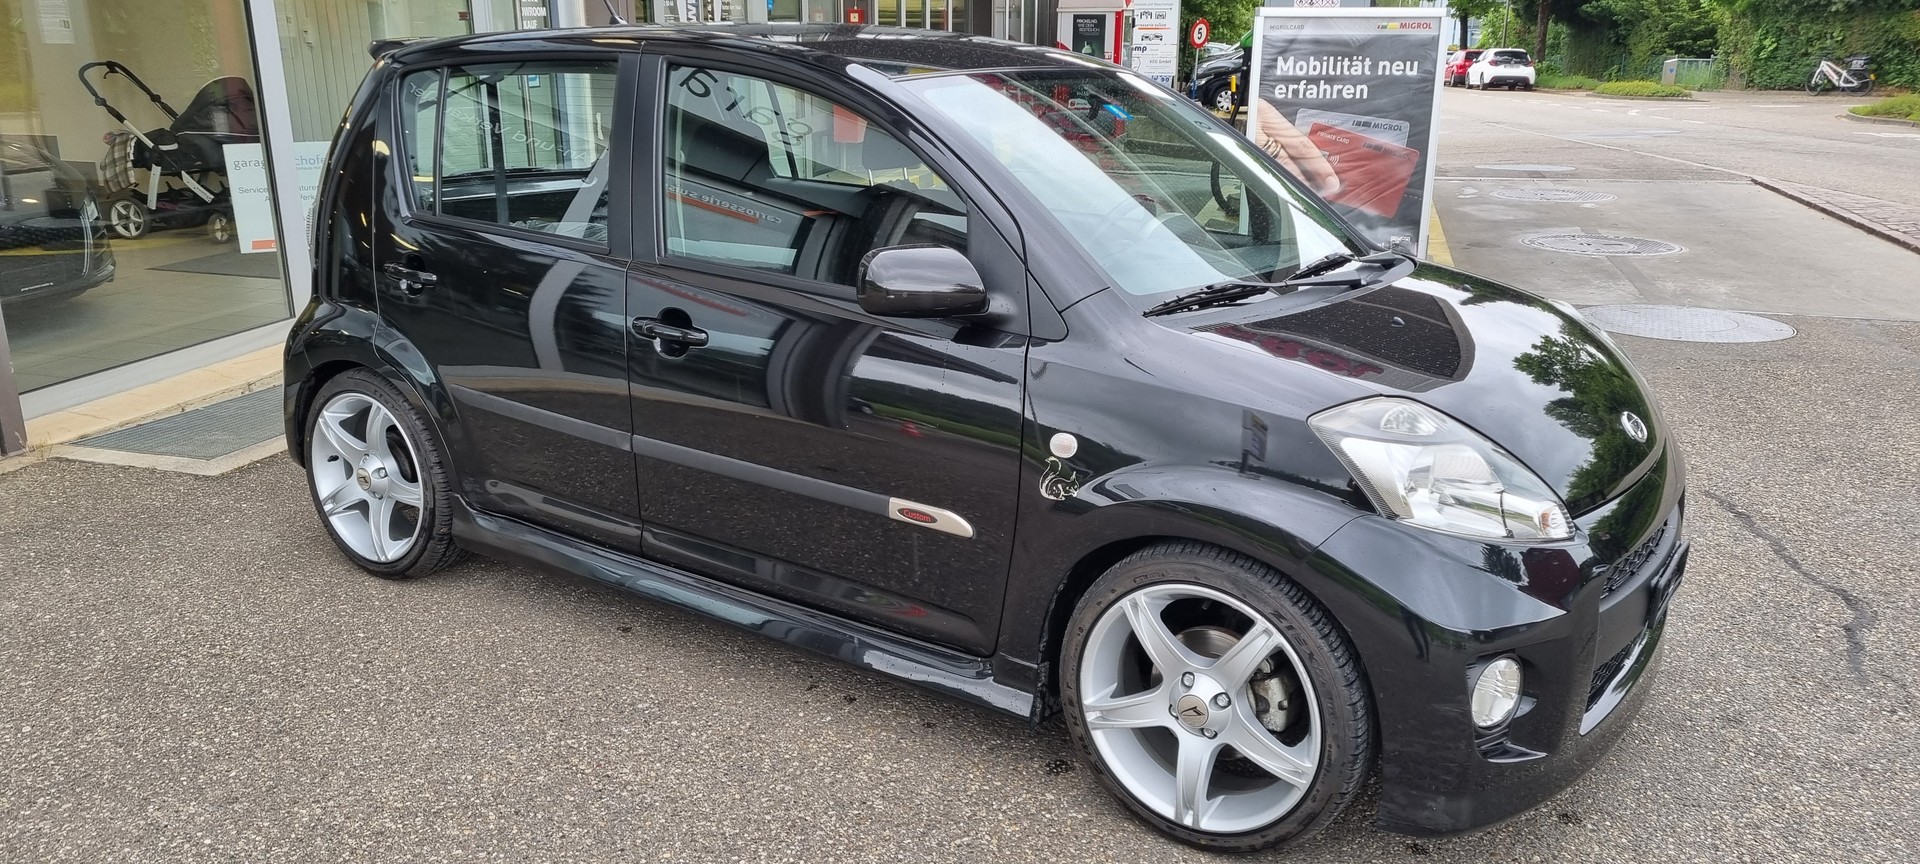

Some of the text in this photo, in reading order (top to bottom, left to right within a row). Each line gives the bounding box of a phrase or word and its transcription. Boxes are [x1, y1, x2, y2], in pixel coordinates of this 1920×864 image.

[521, 7, 547, 16] WROOM
[1399, 22, 1433, 30] MIGROL
[1197, 27, 1203, 40] 5
[1276, 55, 1419, 76] Mobilität neu
[1274, 80, 1368, 99] erfahren
[1372, 121, 1403, 132] MIGROL
[1336, 135, 1350, 145] CARD
[903, 509, 931, 523] Custom
